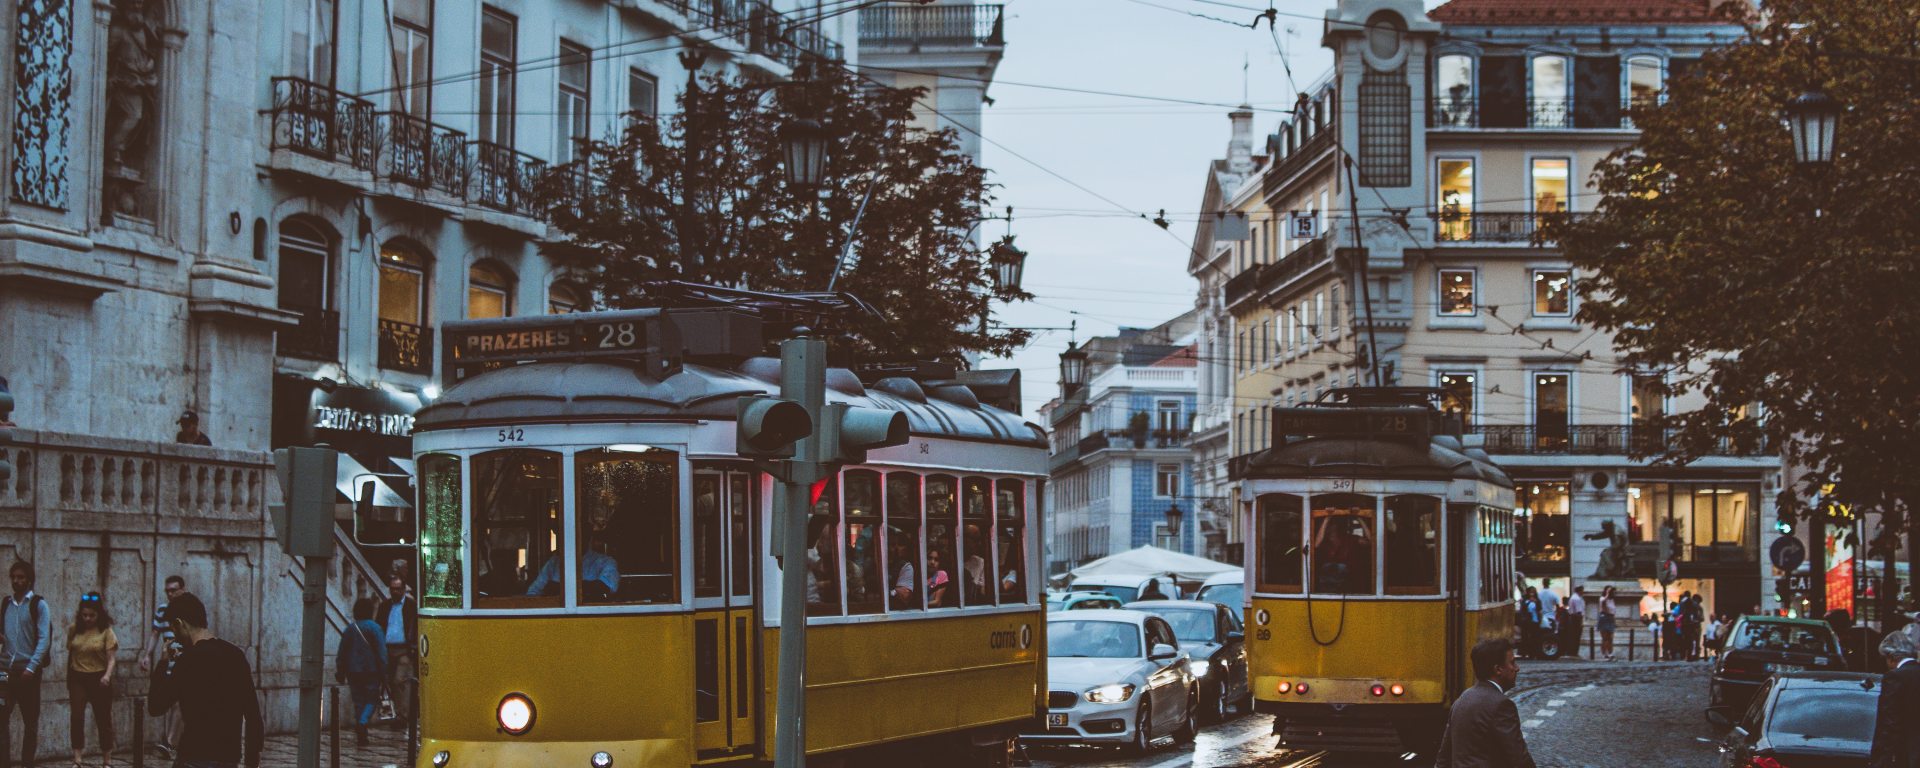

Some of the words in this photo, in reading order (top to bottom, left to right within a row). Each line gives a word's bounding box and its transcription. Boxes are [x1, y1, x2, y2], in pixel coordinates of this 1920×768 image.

[1297, 218, 1311, 230] 15
[467, 330, 569, 350] PRAZERES
[599, 323, 635, 348] 28
[1381, 415, 1407, 431] 28
[498, 429, 524, 442] 542
[1333, 480, 1350, 490] 549
[991, 624, 1016, 649] carris
